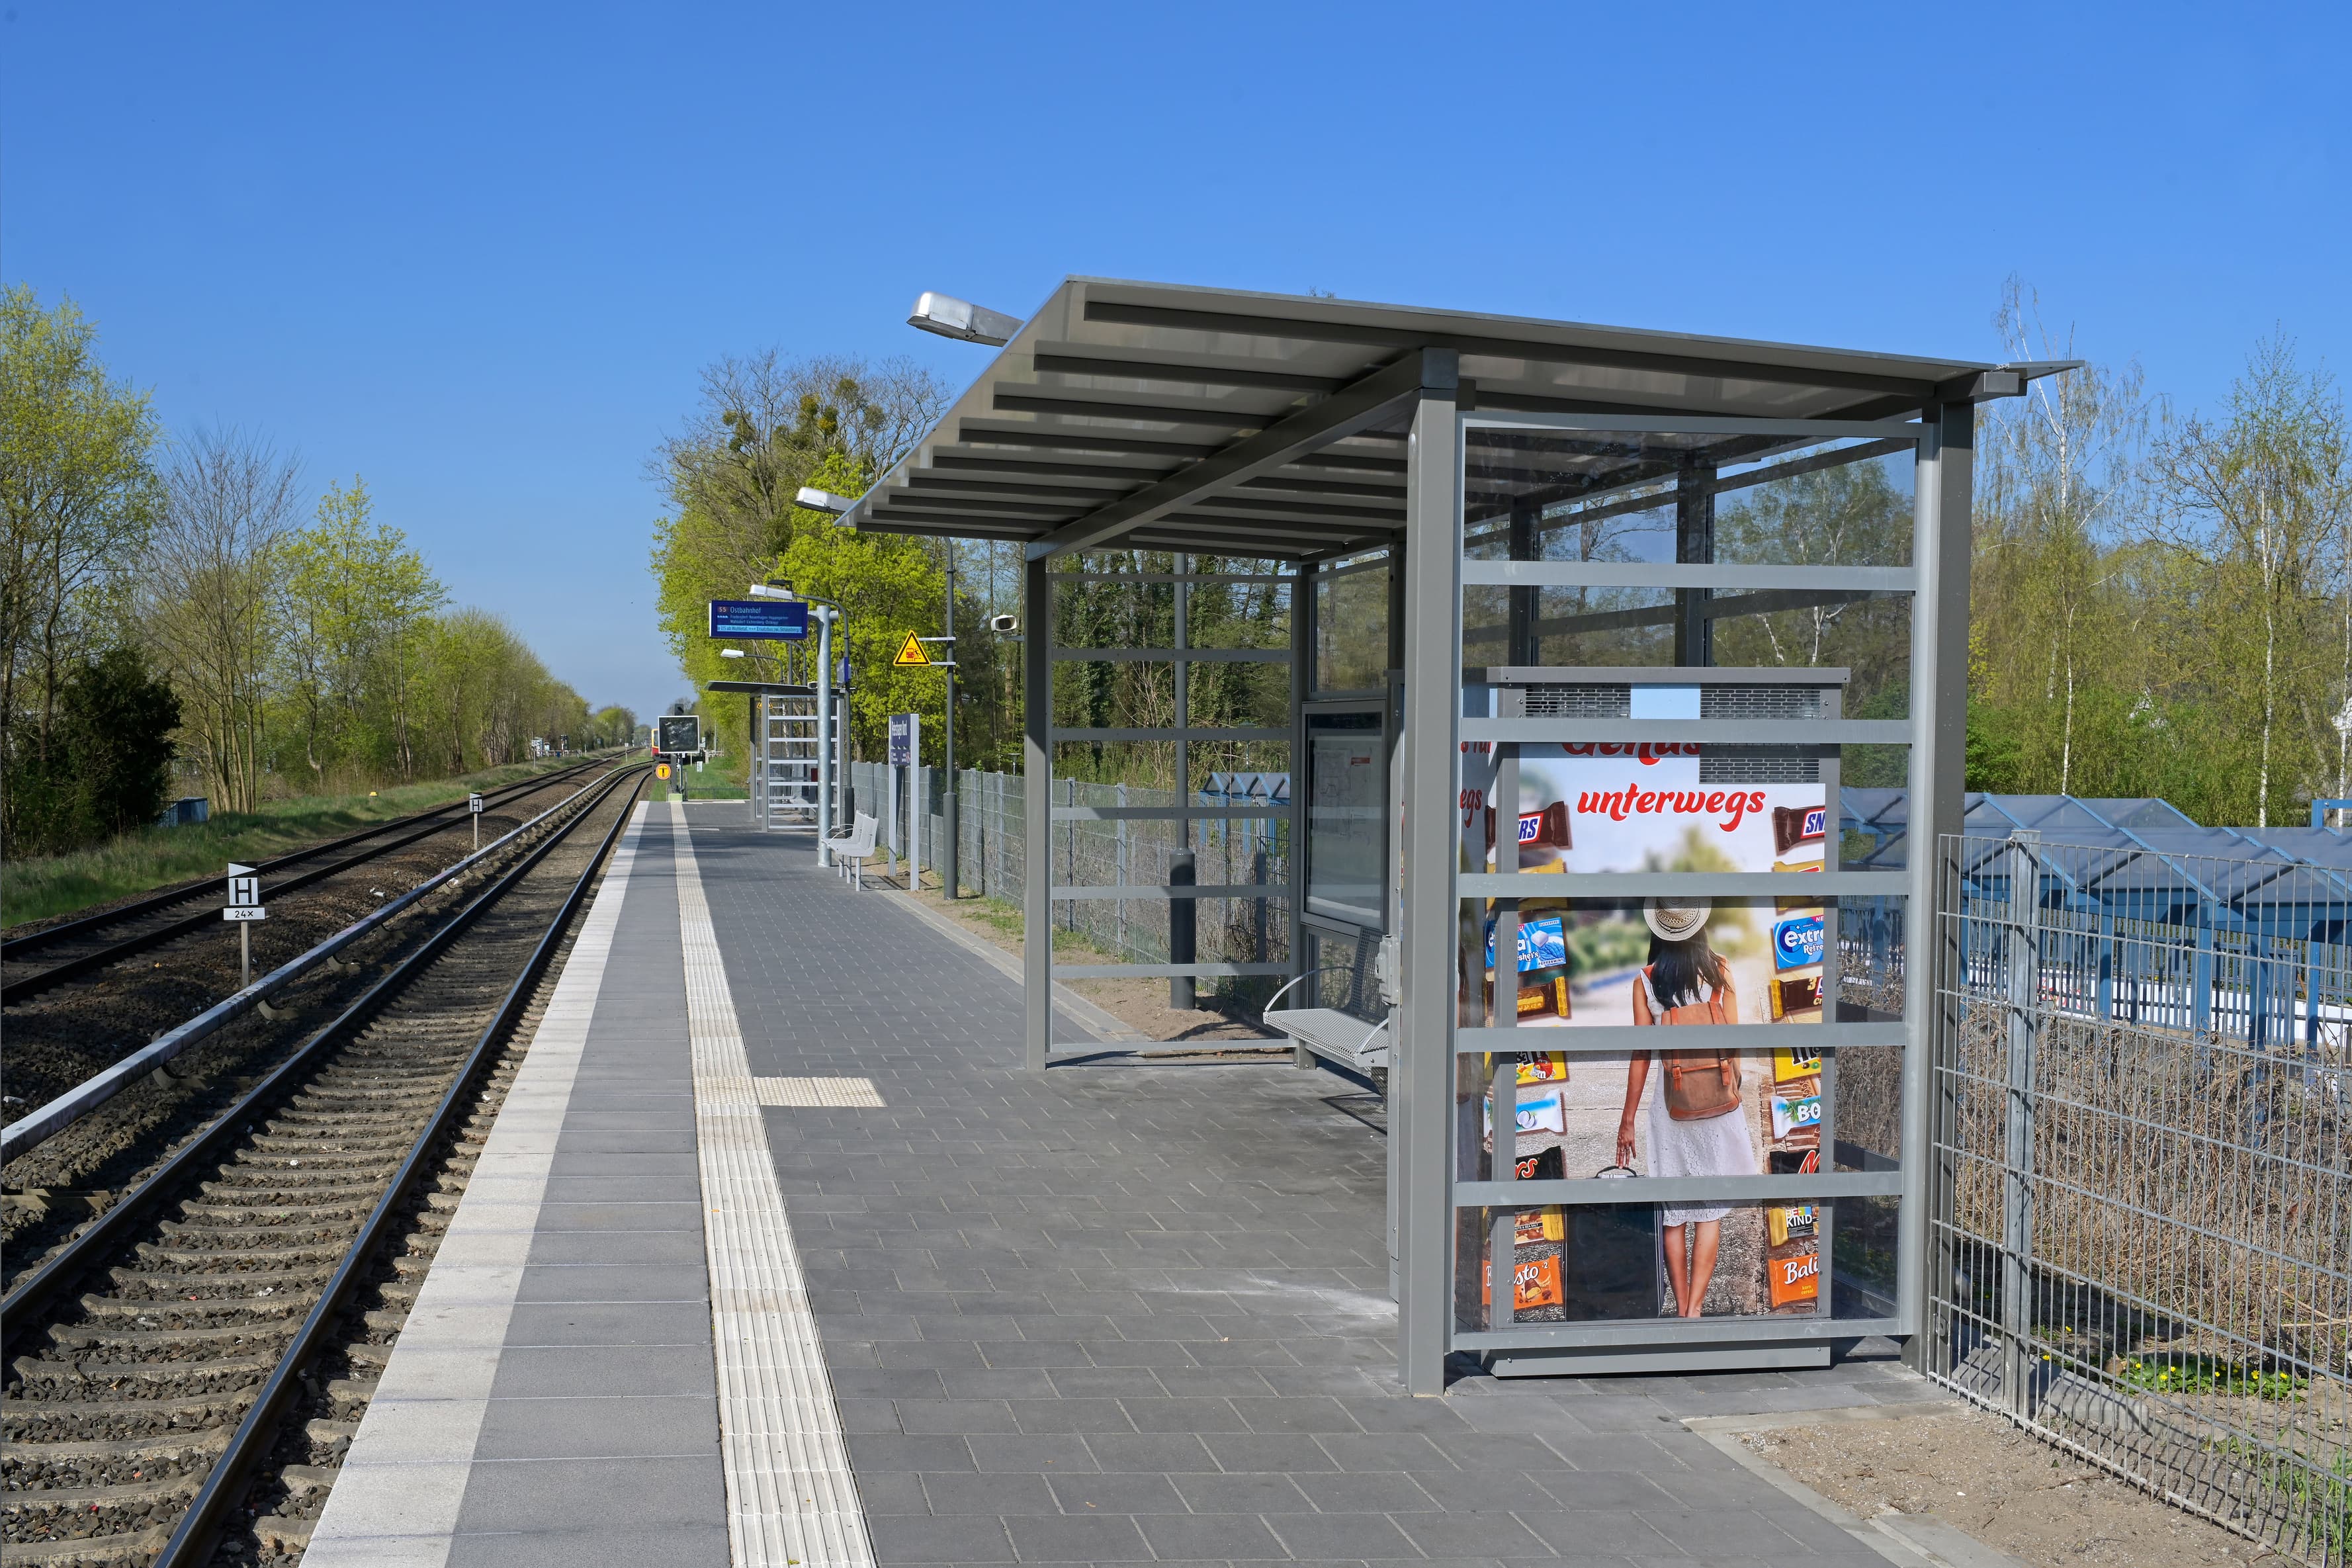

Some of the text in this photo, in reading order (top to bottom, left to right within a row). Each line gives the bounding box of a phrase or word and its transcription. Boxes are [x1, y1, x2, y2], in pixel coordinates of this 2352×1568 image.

[472, 800, 480, 810] H
[1577, 783, 1765, 832] unterwegs
[1519, 818, 1538, 840] RS
[235, 879, 252, 904] H
[1518, 951, 1539, 961] shers
[1786, 1215, 1812, 1228] KIND
